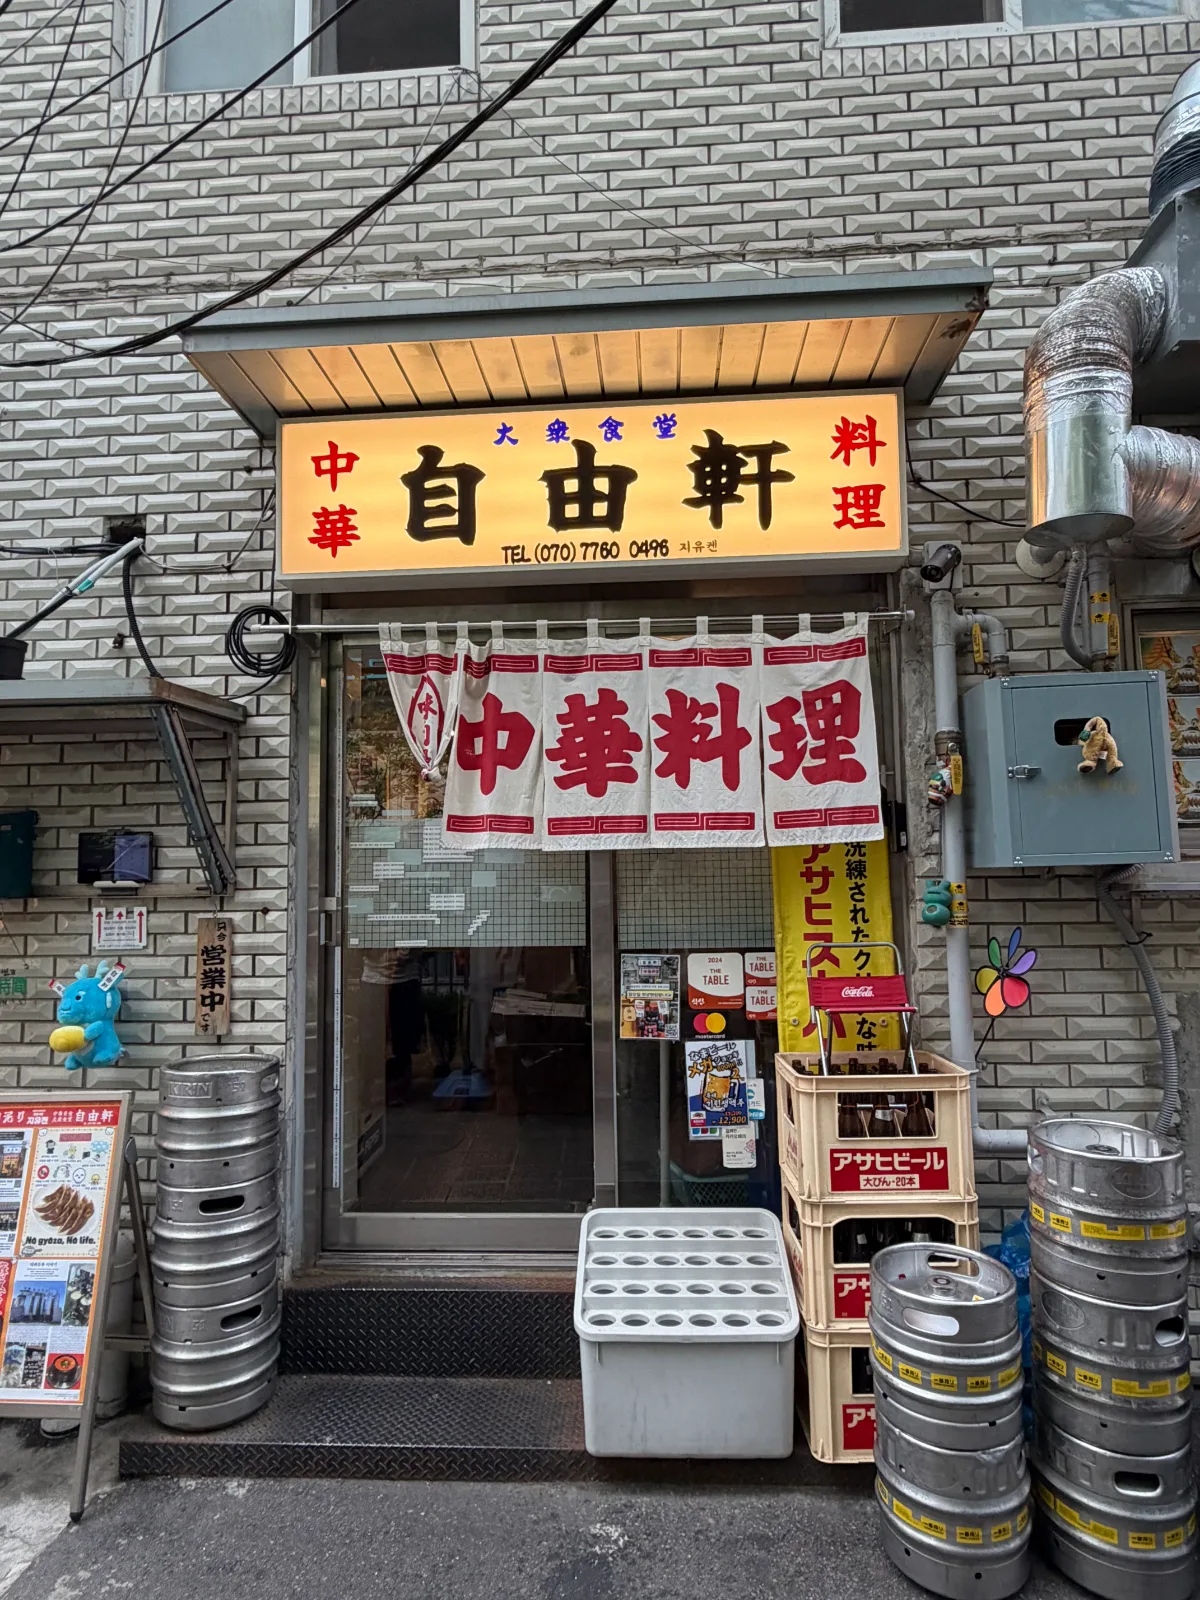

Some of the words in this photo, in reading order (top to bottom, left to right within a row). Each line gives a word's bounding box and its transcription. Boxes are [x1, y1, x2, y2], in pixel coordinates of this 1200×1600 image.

[493, 413, 677, 446] 大衆食堂
[830, 414, 887, 530] 料理
[400, 429, 795, 546] 自由軒
[308, 440, 361, 559] 中華
[501, 543, 531, 565] TEL
[534, 541, 577, 564] (070)
[629, 538, 669, 559] 0496
[456, 680, 868, 798] 中華料理
[217, 921, 227, 942] 只今
[749, 962, 775, 972] TABLE
[200, 944, 227, 1013] 営業中
[703, 974, 730, 986] TABLE
[750, 995, 776, 1006] TABLE
[841, 986, 874, 998] Coca-Cola
[201, 1012, 211, 1033] です
[169, 1082, 210, 1097] KIRIN
[76, 1108, 114, 1123] 自由軒
[833, 1152, 945, 1172] アサヒビール
